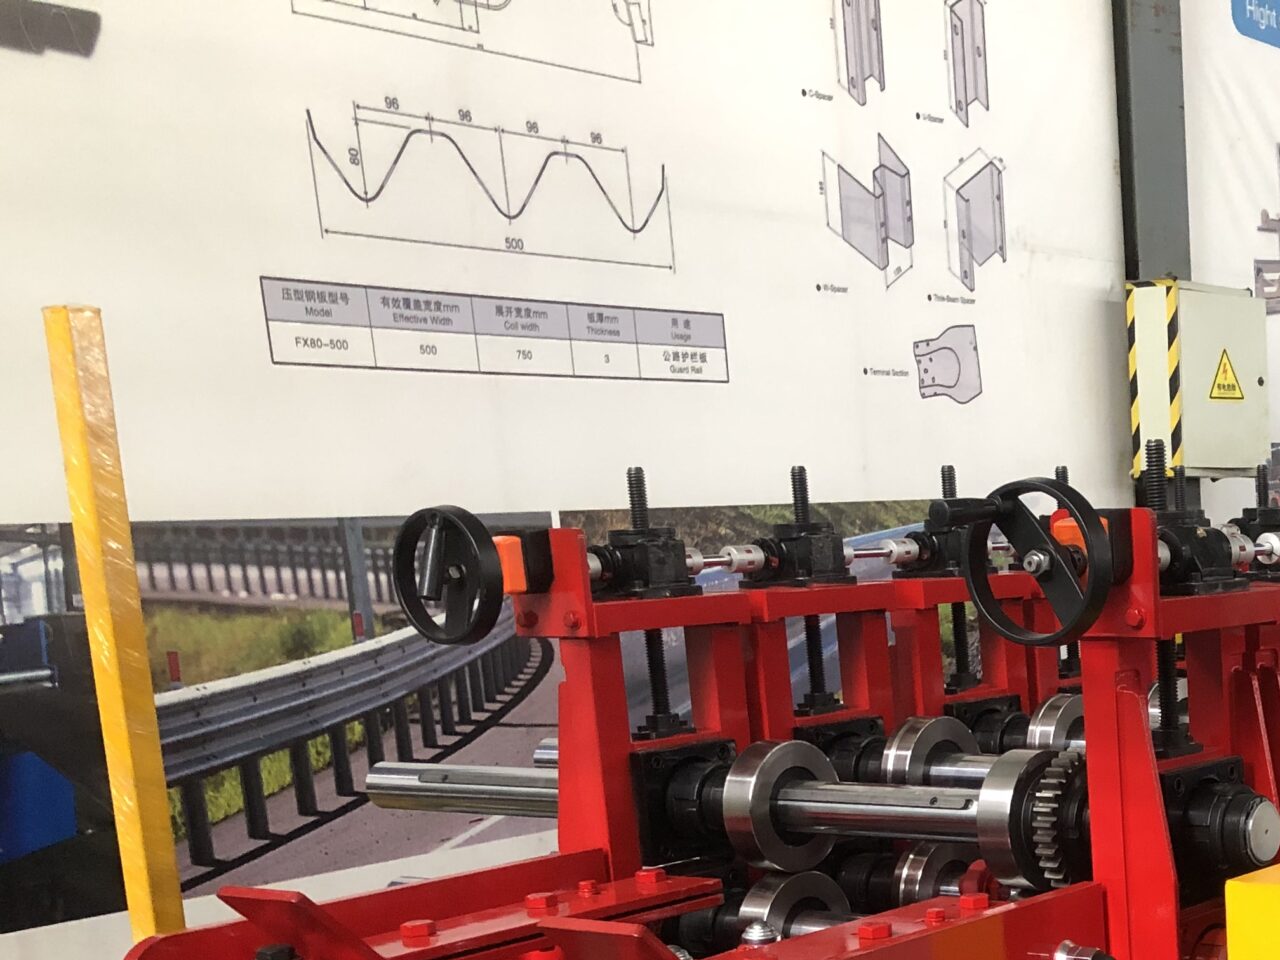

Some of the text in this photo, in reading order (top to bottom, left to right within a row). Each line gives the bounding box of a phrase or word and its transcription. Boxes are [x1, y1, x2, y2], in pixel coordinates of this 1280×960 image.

[384, 96, 400, 111] 96
[458, 108, 473, 123] 96
[526, 120, 540, 135] 96
[590, 131, 603, 145] 96
[348, 148, 361, 167] 80
[504, 238, 524, 251] 500
[305, 307, 332, 318] Model
[393, 313, 453, 327] Effective Width
[520, 322, 540, 332] width
[586, 326, 621, 337] Thickness
[294, 336, 349, 351] FX80-500
[419, 345, 438, 356] 500
[516, 350, 533, 361] 750
